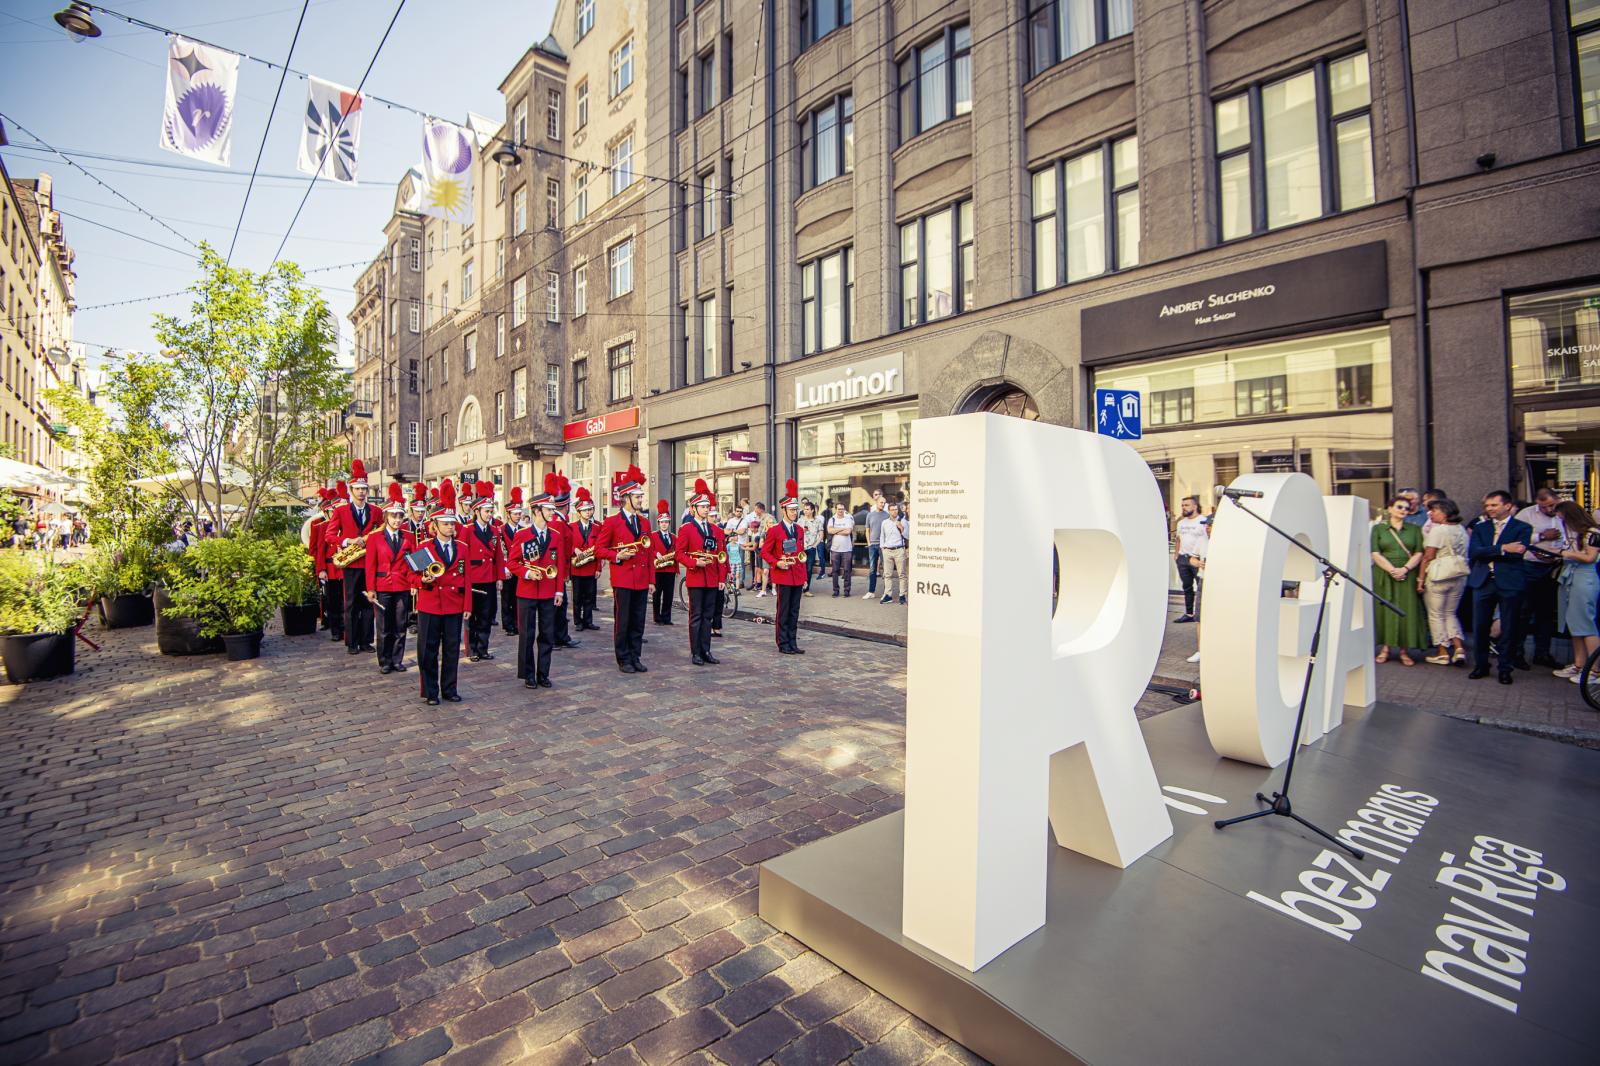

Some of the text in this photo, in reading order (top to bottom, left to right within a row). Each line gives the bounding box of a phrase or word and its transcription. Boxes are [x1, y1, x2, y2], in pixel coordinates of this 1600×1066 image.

[1160, 284, 1276, 318] ANDREY SILCHENKO
[796, 367, 898, 408] Luminor
[1246, 783, 1440, 942] bez manis
[1420, 896, 1531, 1014] nav
